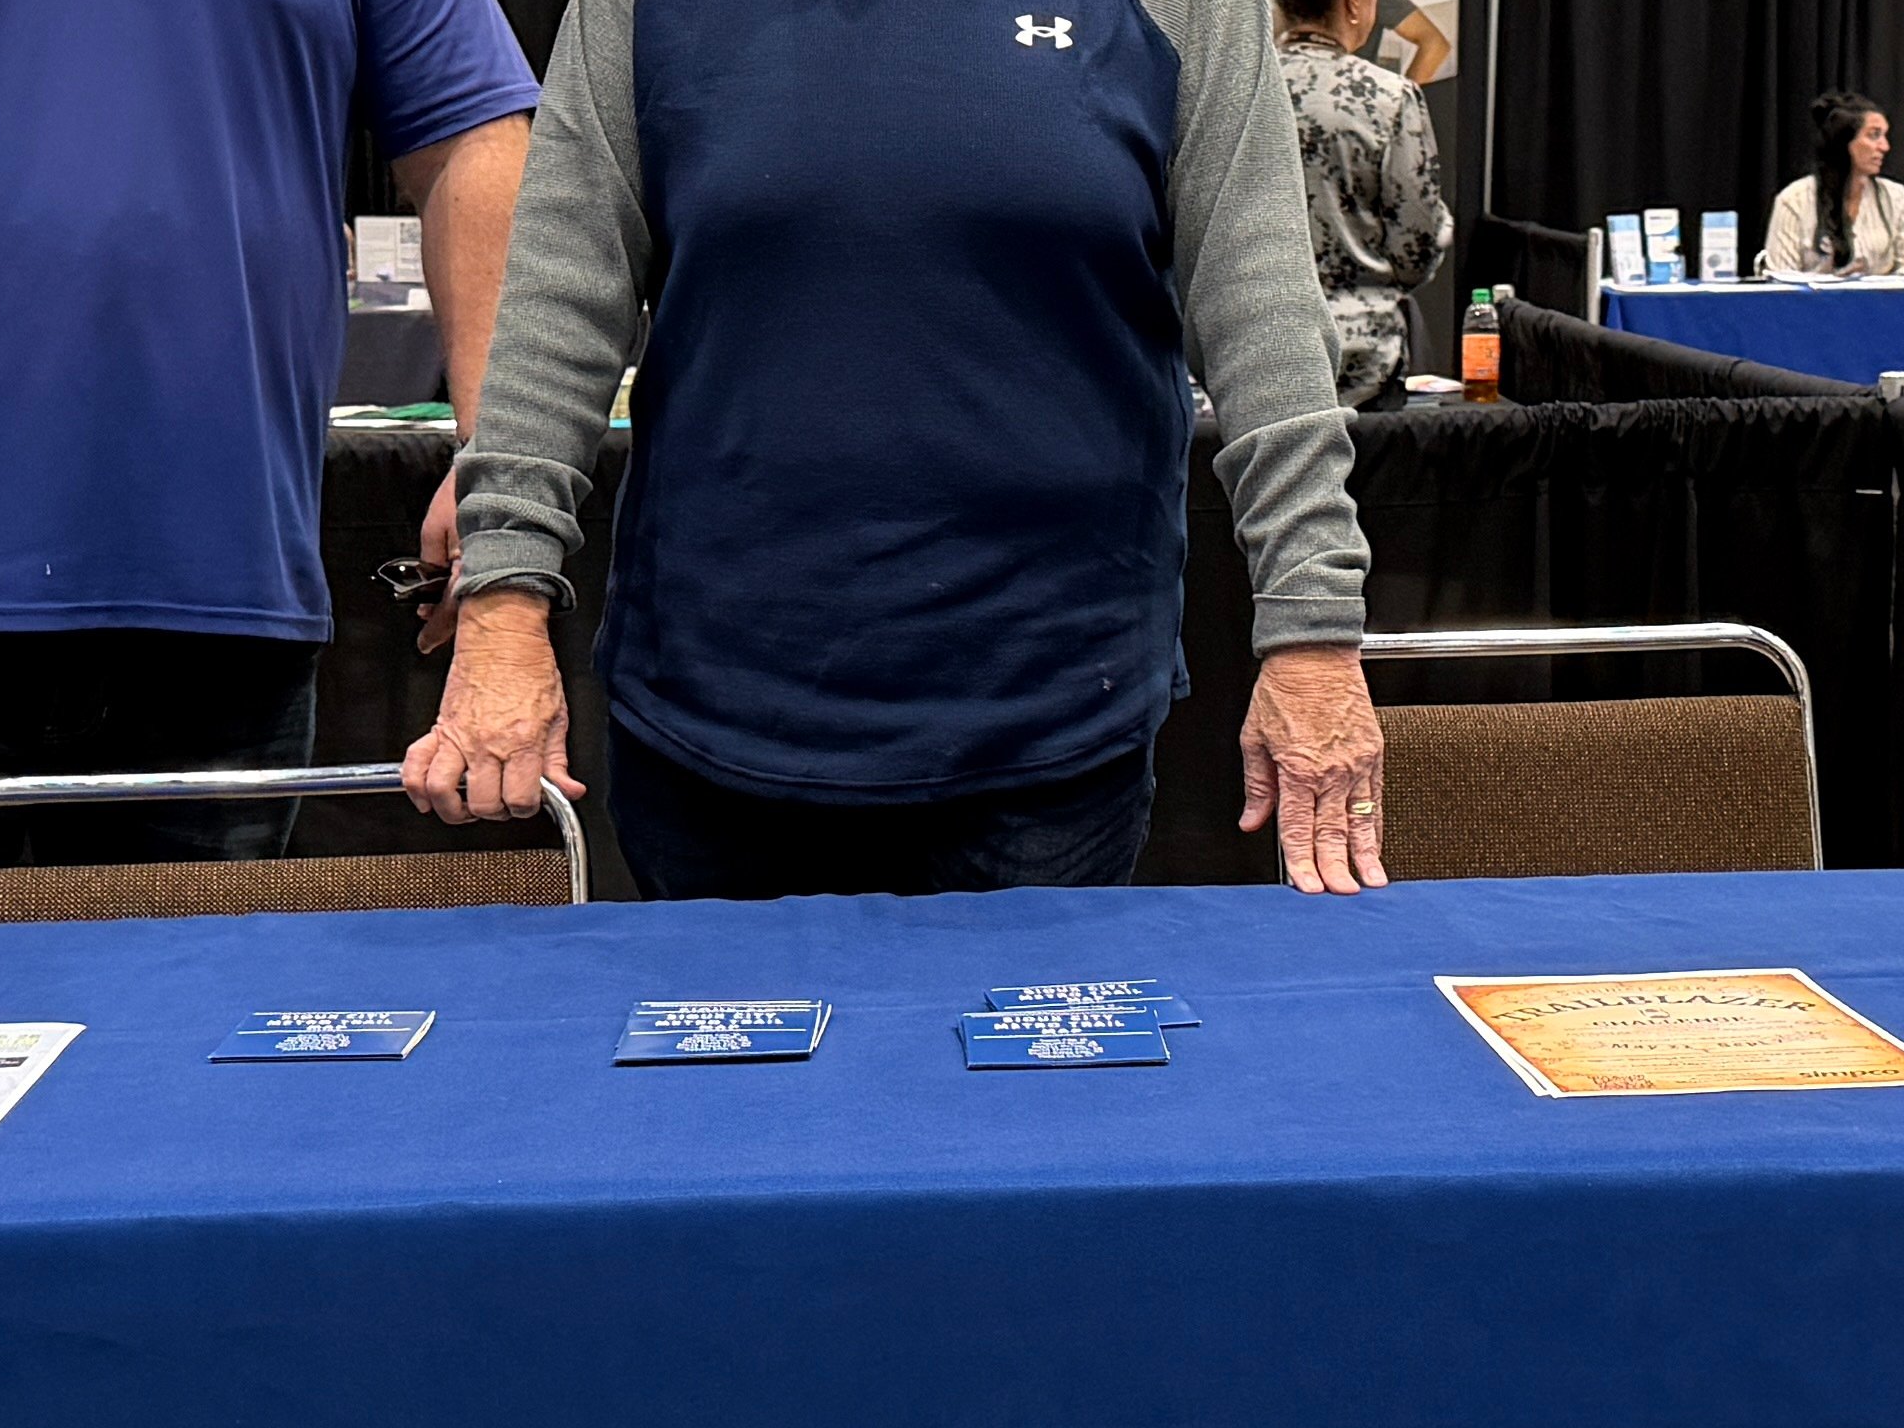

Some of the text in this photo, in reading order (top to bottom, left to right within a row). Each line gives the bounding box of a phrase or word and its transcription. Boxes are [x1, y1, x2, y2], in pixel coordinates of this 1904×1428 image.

[1087, 982, 1129, 991] CITY
[1490, 995, 1817, 1022] TRAILBLAZER
[345, 1011, 391, 1020] CITY
[666, 1012, 778, 1021] SIOUX CITY
[1002, 1013, 1114, 1023] SIOUX CITY
[993, 1020, 1125, 1030] METRO TRAIL
[1611, 1042, 1658, 1050] May
[1799, 1068, 1901, 1078] simpco
